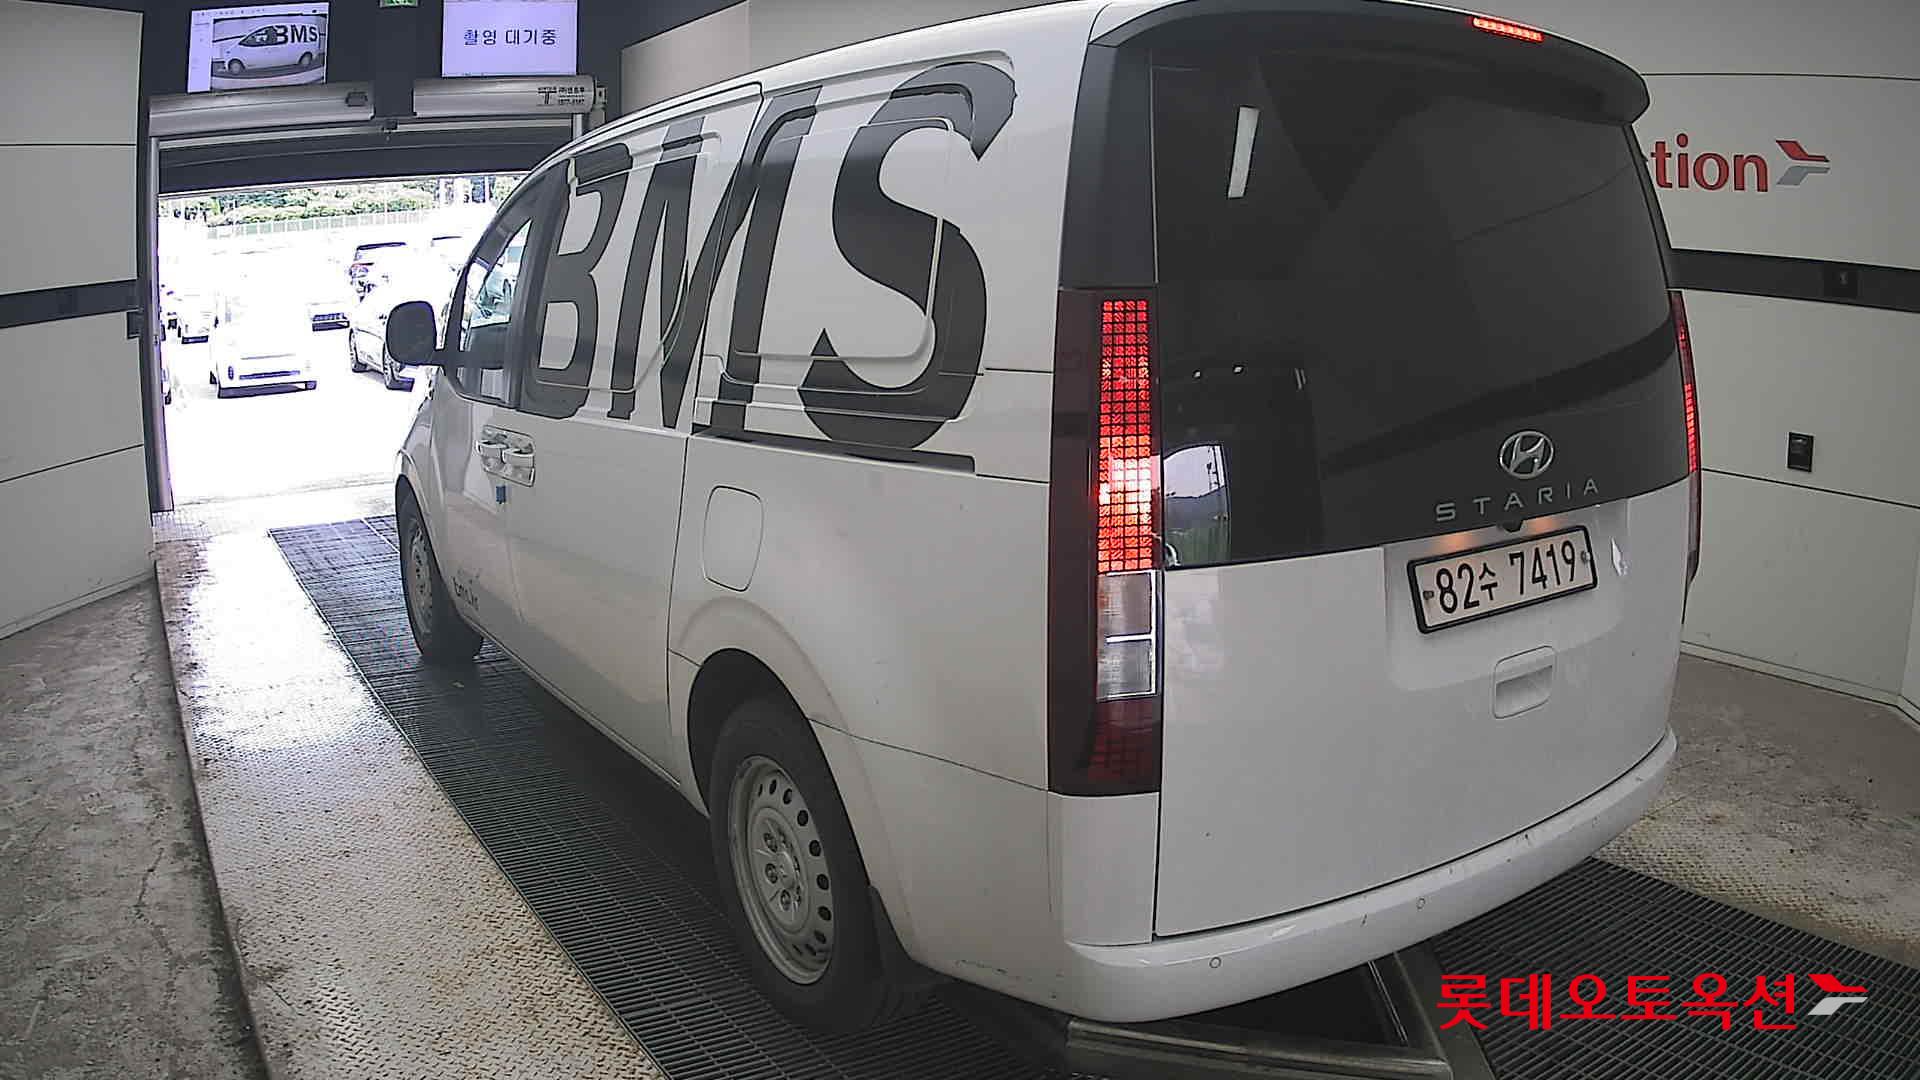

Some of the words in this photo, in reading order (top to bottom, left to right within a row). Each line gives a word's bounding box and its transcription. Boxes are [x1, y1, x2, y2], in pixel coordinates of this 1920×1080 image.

[464, 29, 497, 46] 촬영
[505, 29, 557, 45] 대기중
[1650, 132, 1769, 193] tion
[517, 61, 1017, 449] BMS
[1435, 478, 1599, 523] STARIA
[1435, 562, 1499, 614] 82수
[1509, 539, 1577, 596] 7419
